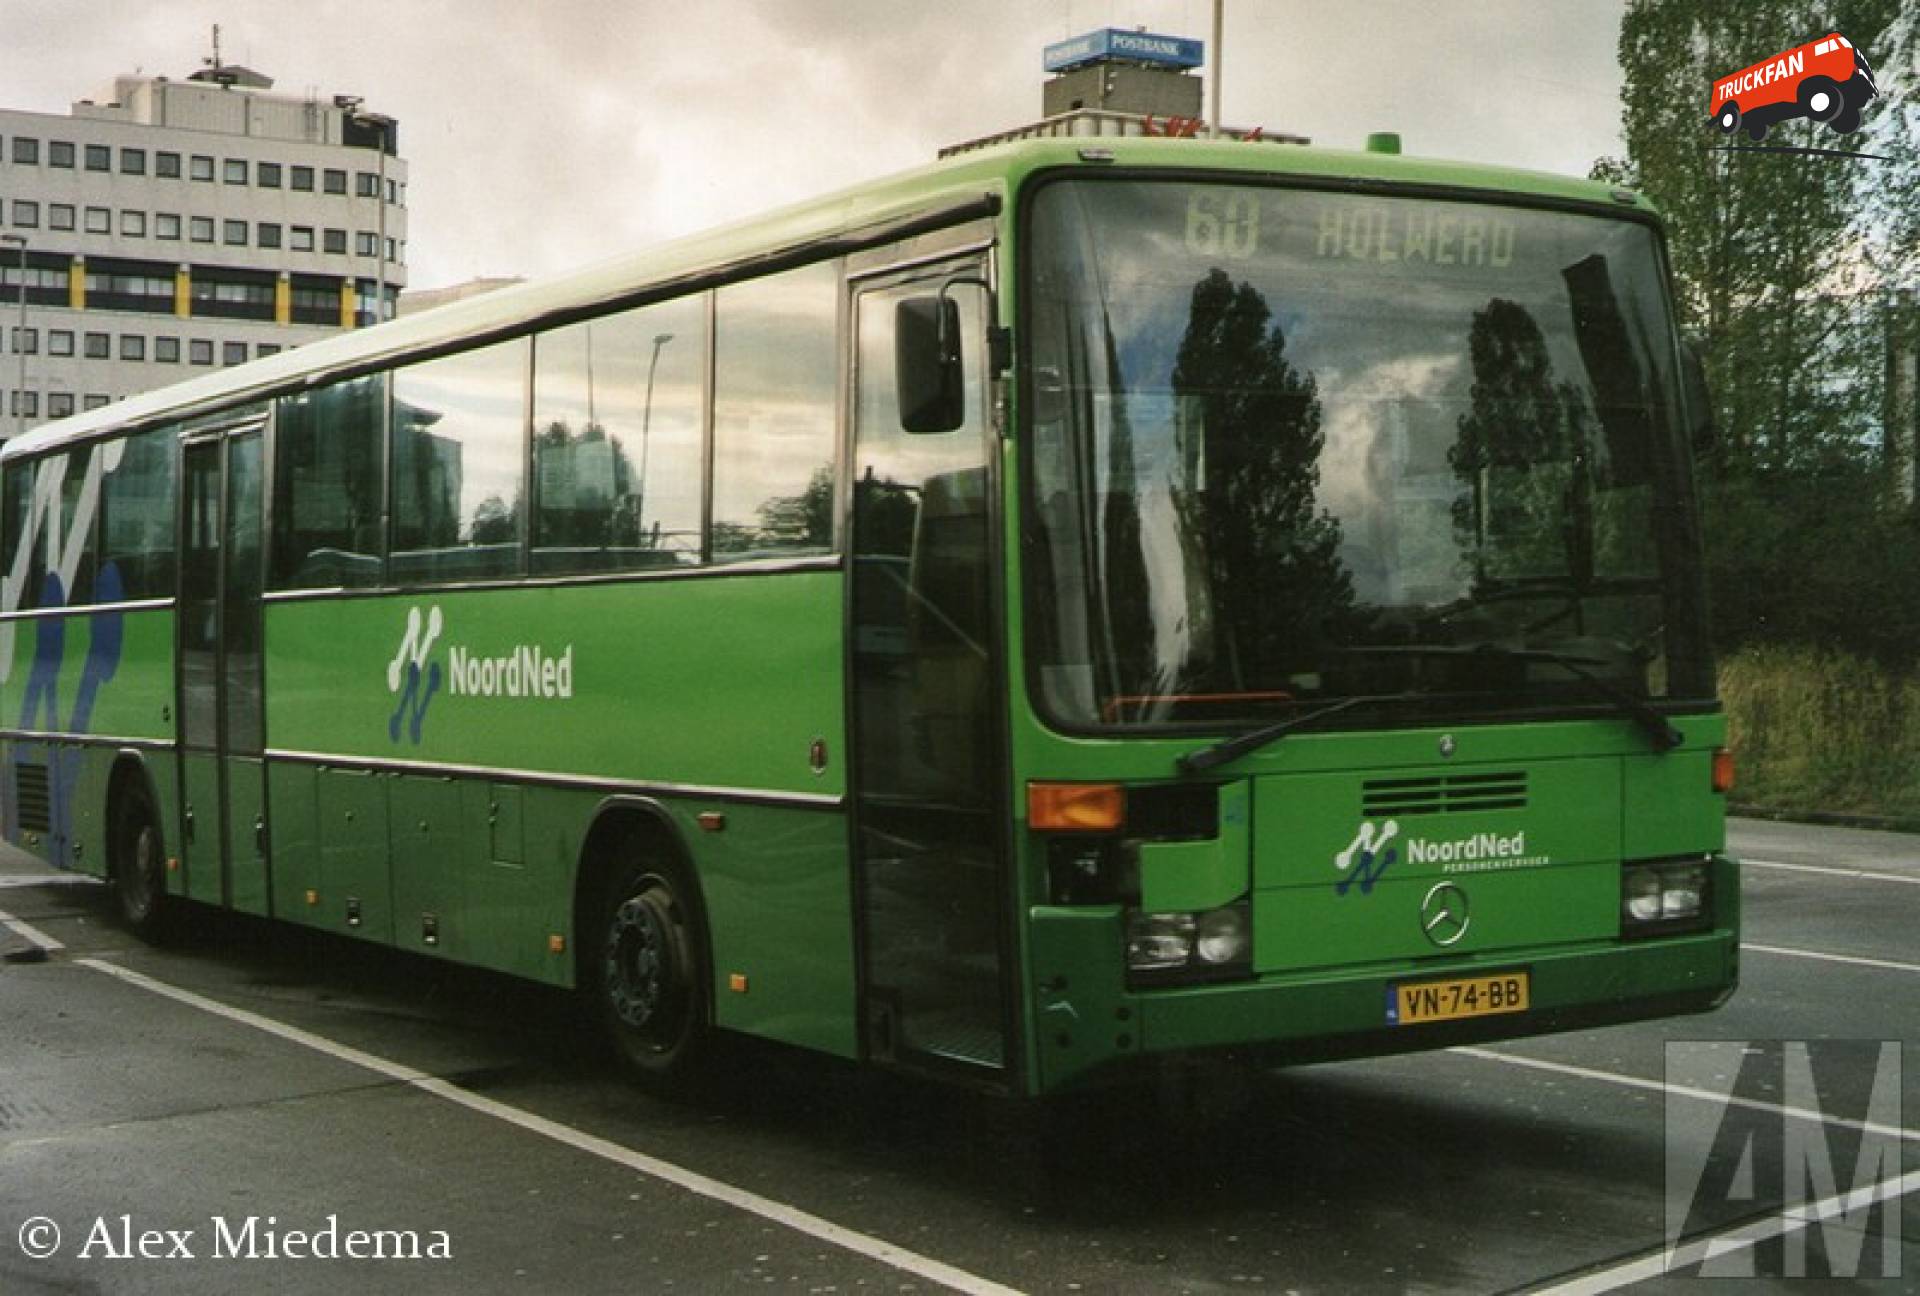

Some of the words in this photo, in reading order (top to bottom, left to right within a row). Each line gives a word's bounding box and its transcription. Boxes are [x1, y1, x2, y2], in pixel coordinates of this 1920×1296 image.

[1318, 208, 1516, 268] HOLWERD
[449, 644, 573, 699] NoordNed
[1407, 830, 1525, 864] NoordNed
[1405, 979, 1520, 1017] VN-74-BB
